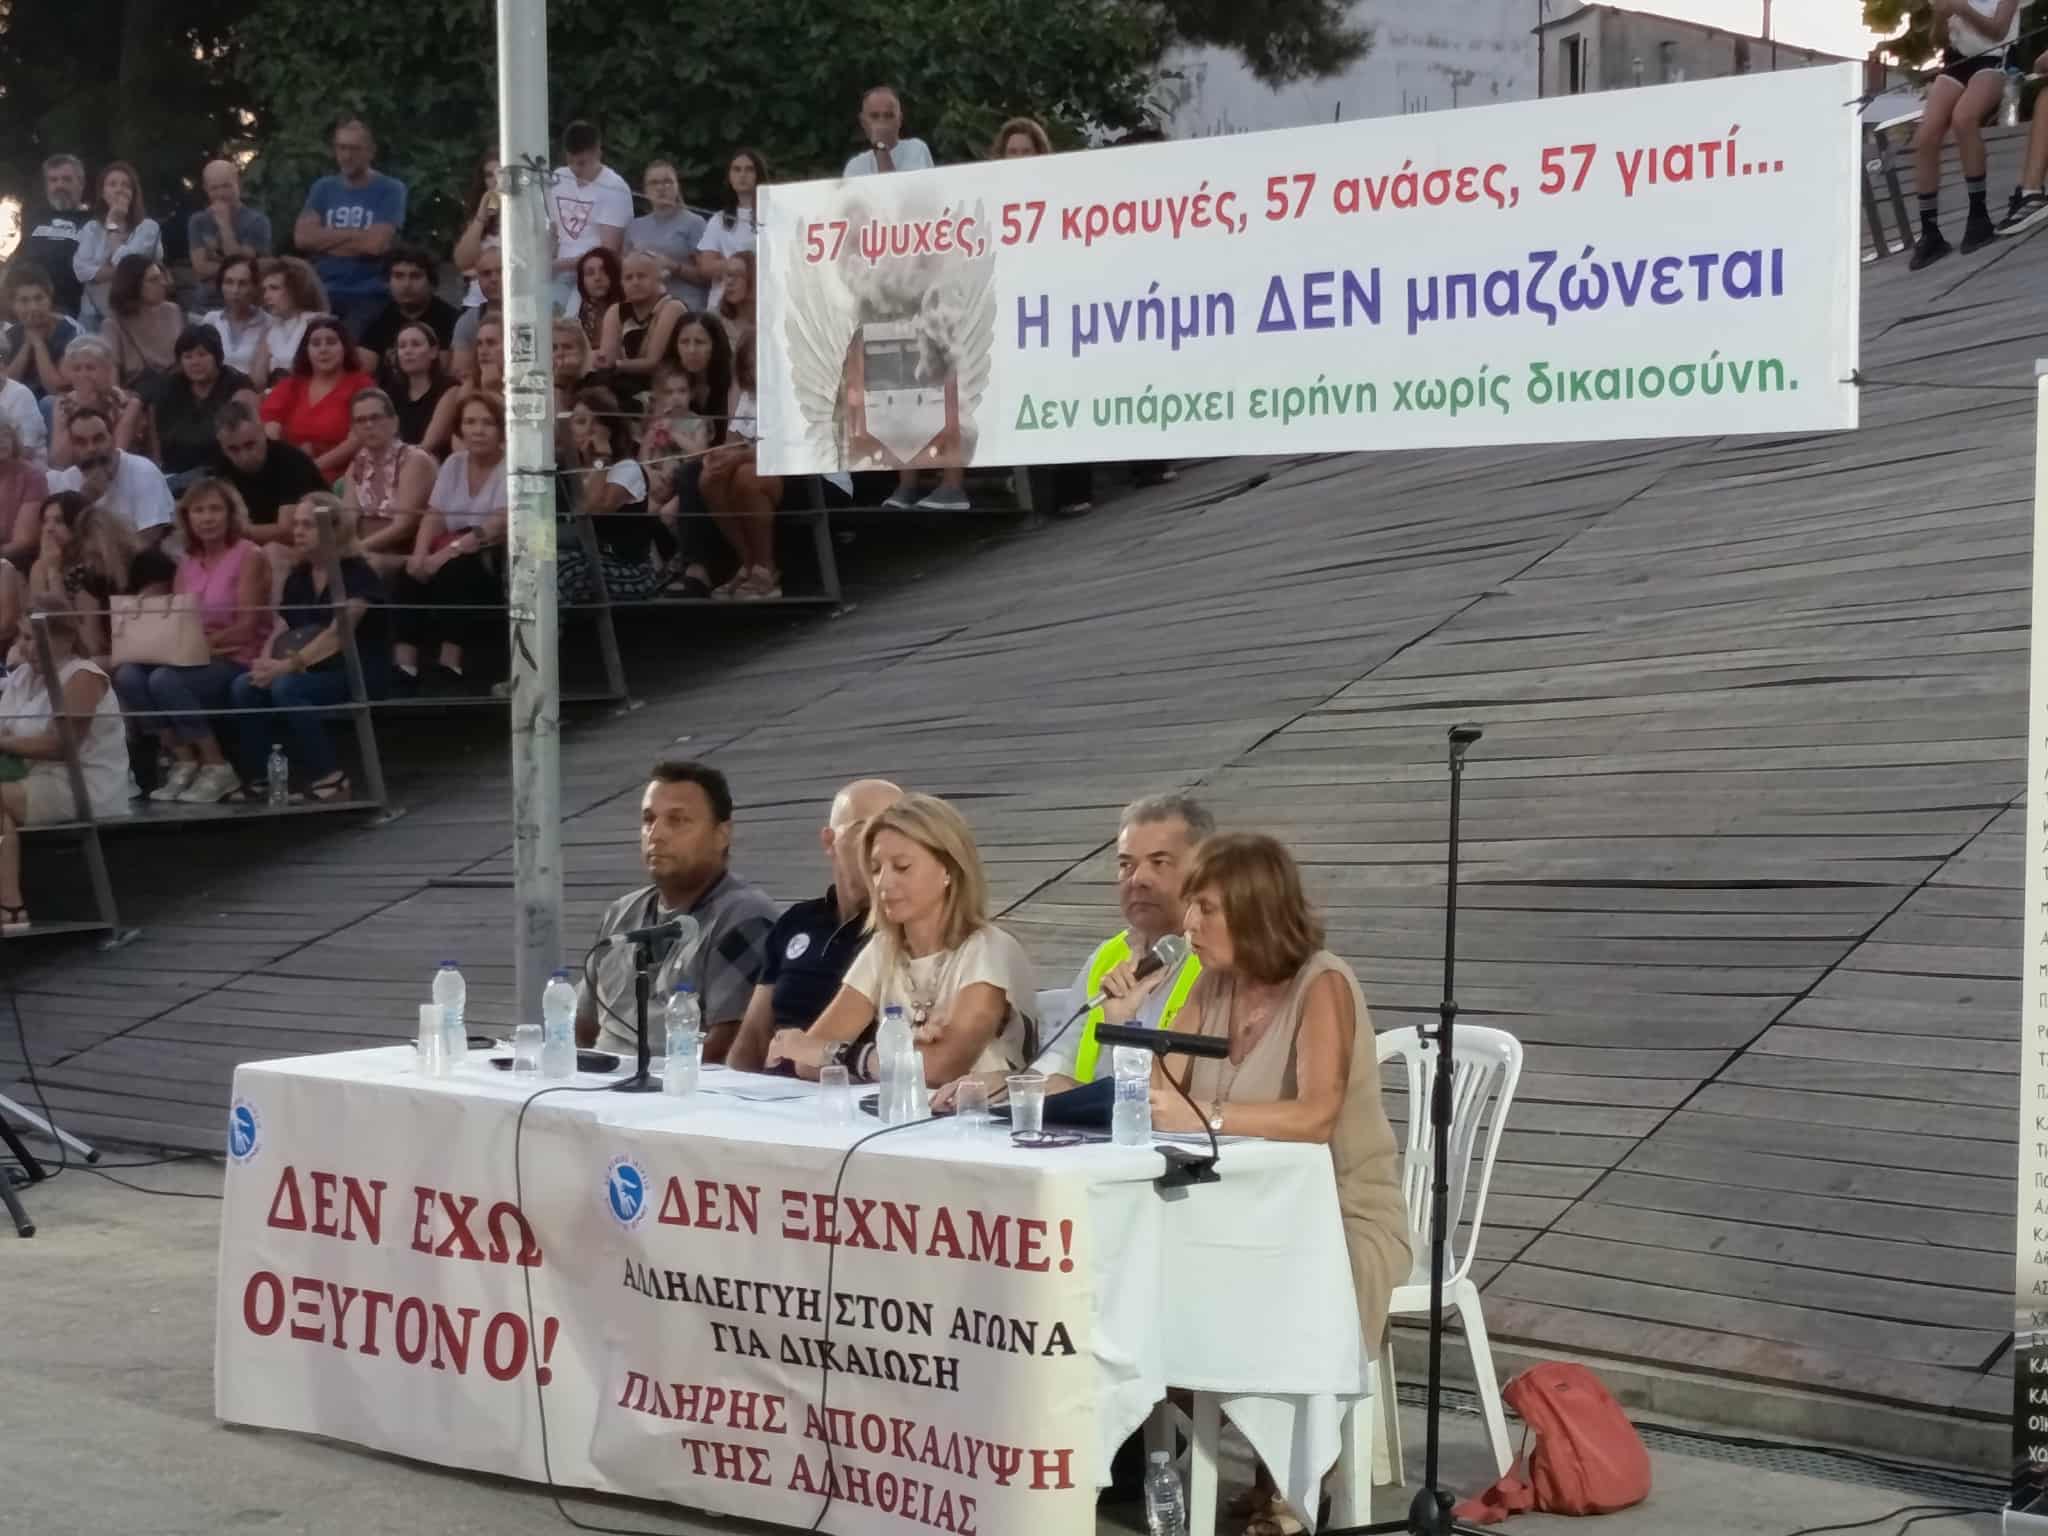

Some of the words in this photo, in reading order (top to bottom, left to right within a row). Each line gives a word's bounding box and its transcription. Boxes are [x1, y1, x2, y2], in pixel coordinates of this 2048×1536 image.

[805, 220, 849, 263] 57
[861, 206, 986, 266] ψυχές,
[1000, 200, 1047, 246] 57
[1061, 180, 1248, 246] κραυγές,
[1265, 173, 1316, 222] 57
[1334, 160, 1520, 214] ανάσες,
[1539, 143, 1597, 195] 57
[1616, 125, 1784, 197] γιατί...
[1017, 295, 1049, 349] Η
[1072, 282, 1234, 357] μνήμη
[1257, 267, 1381, 333] ΔΕΝ
[1407, 246, 1784, 336] μπαζώνεται
[1015, 394, 1079, 430] Δεν
[1093, 384, 1234, 430] υπάρχει
[1249, 373, 1376, 425] ειρήνη
[1393, 365, 1510, 417] χωρίς
[1527, 350, 1799, 403] δικαιοσύνη.
[267, 1165, 388, 1245] ΔΕΝ
[411, 1186, 543, 1268] ΕΧΩ
[658, 1176, 762, 1234] ΔΕΝ
[782, 1190, 1075, 1273] ΞΕΧΝΑΜΕ!
[243, 1270, 560, 1386] ΟΞΥΓΟΝΟ!
[623, 1258, 821, 1322] ΑΛΛΗΛΕΓΓΥΗ
[833, 1292, 933, 1337] ΣΤΟΝ
[949, 1307, 1077, 1357] ΑΓΩΝΑ
[710, 1322, 770, 1360] ΓΙΑ
[780, 1334, 960, 1392] ΔΙΚΑΙΩΣΗ
[618, 1371, 787, 1434] ΠΛΗΡΗΣ
[804, 1403, 1075, 1489] ΑΠΟΚΑΛΥΨΗ
[682, 1438, 773, 1486] ΤΗΣ
[788, 1454, 977, 1536] ΑΛΗΘΕΙΑΣ
